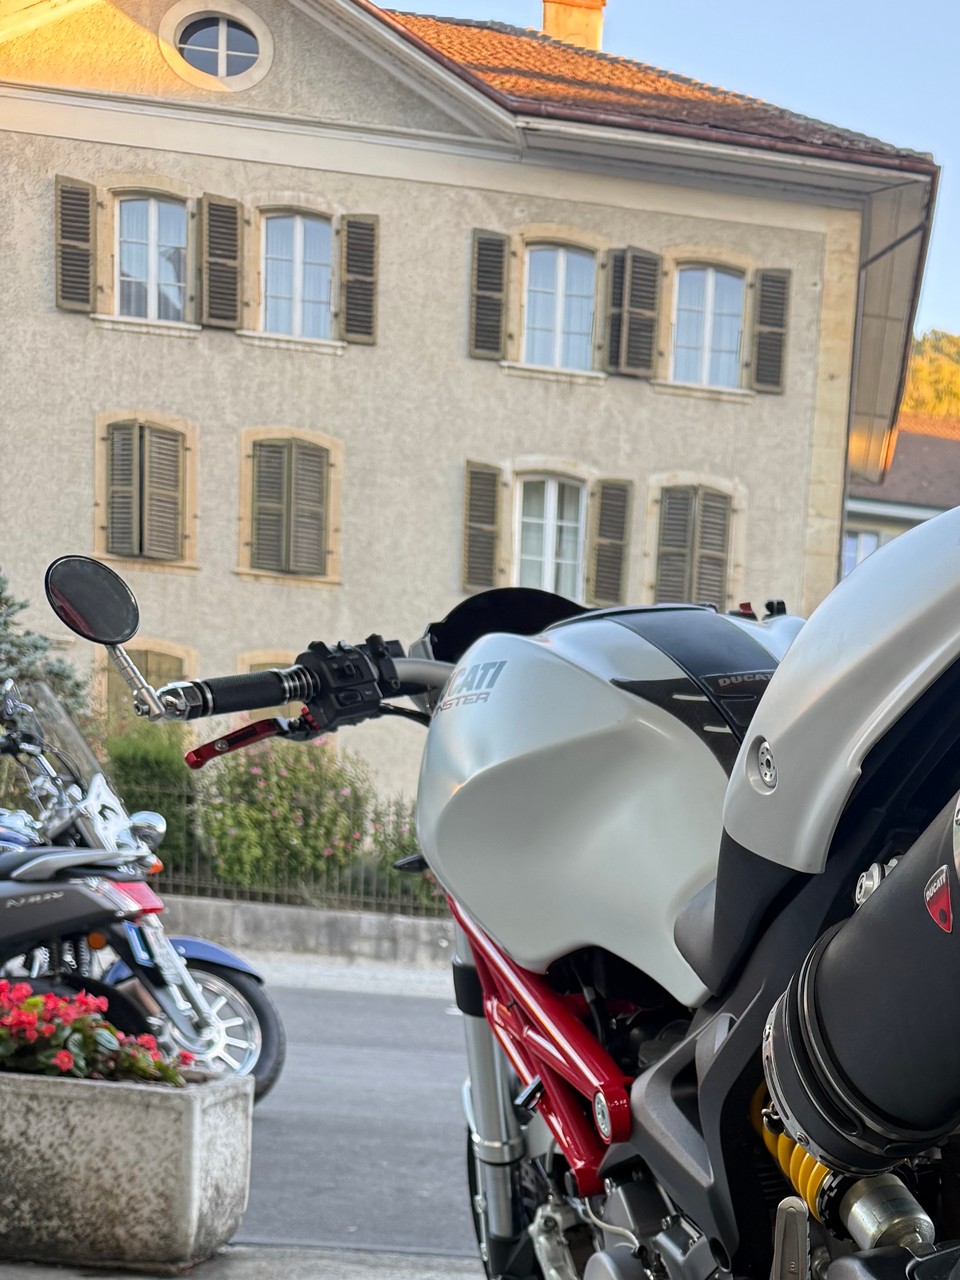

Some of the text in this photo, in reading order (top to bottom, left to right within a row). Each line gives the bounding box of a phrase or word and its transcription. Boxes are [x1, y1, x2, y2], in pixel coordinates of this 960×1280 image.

[447, 660, 508, 697] CATI
[717, 673, 772, 687] DUCAT
[432, 691, 491, 719] NSTER
[925, 873, 947, 902] DUCATI
